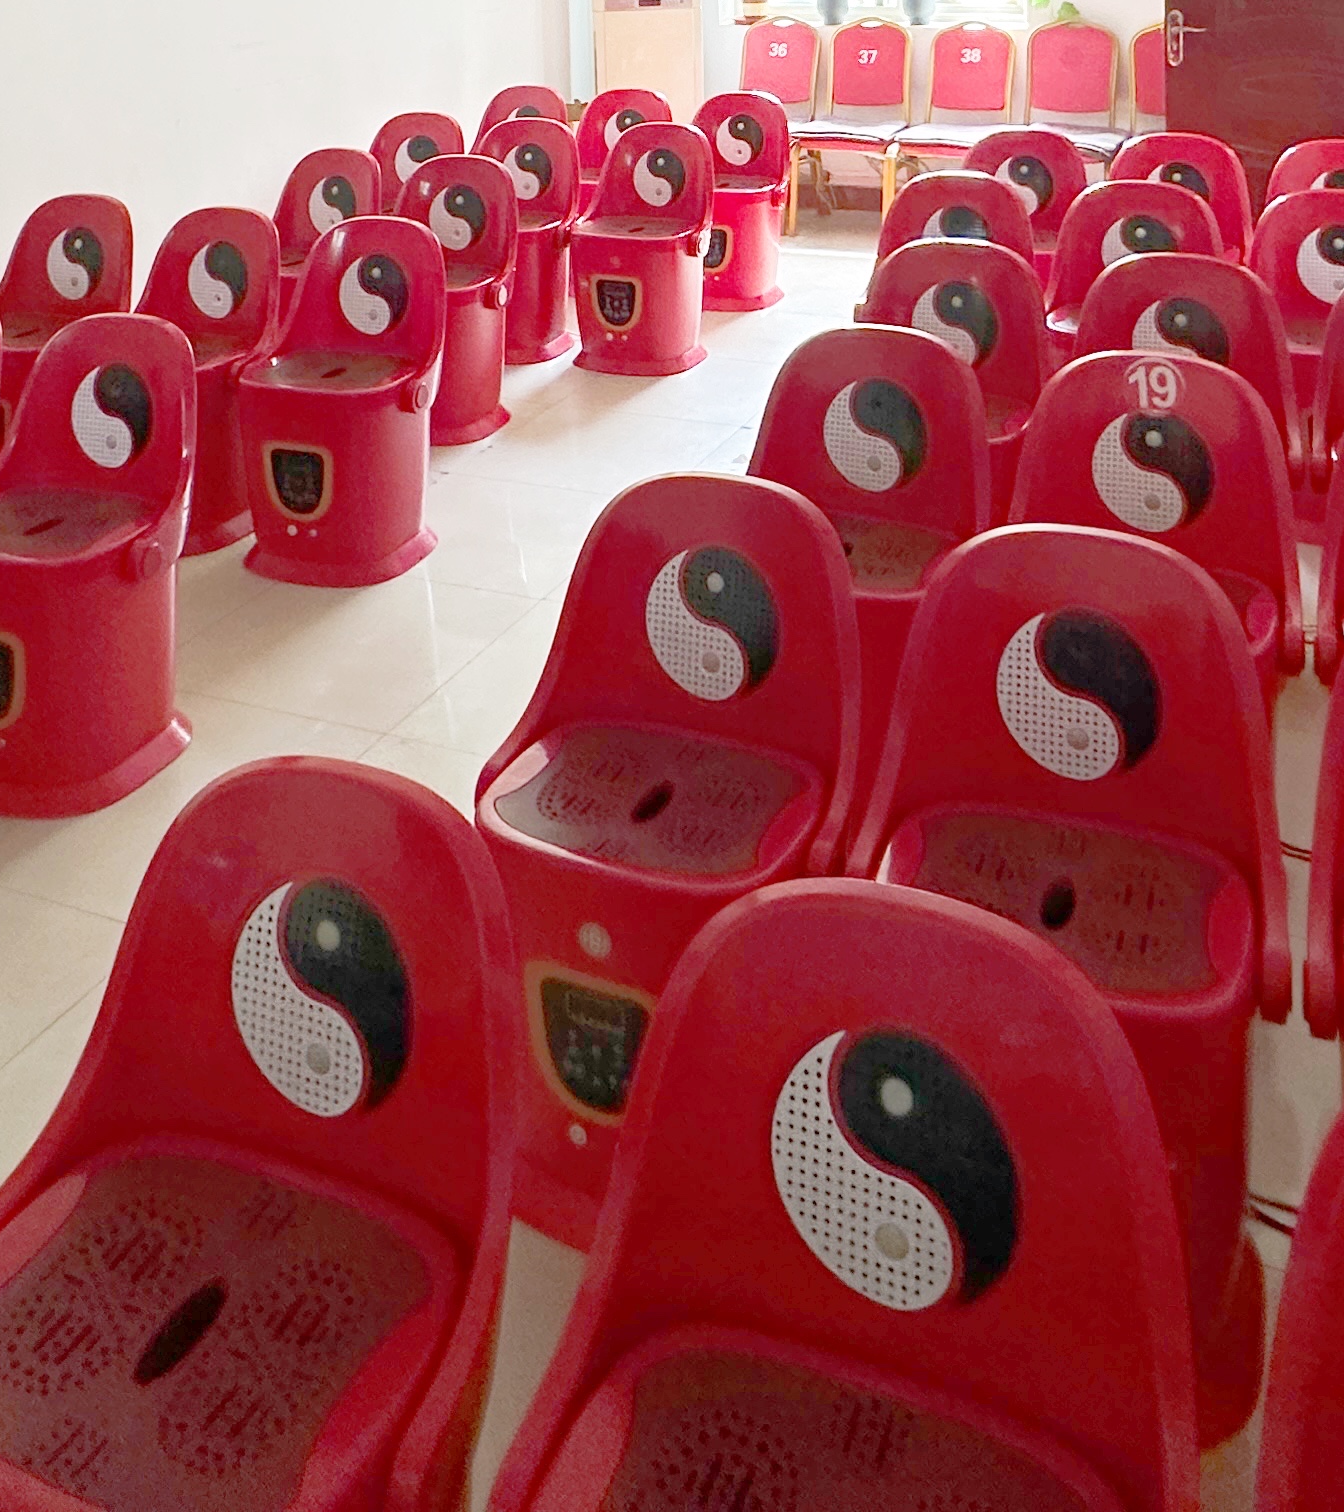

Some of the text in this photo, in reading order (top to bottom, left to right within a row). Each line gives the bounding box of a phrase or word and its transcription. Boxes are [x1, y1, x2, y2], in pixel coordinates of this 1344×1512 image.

[768, 42, 788, 59] 36
[858, 48, 878, 65] 37
[960, 47, 982, 64] 38
[1128, 365, 1177, 409] 19
